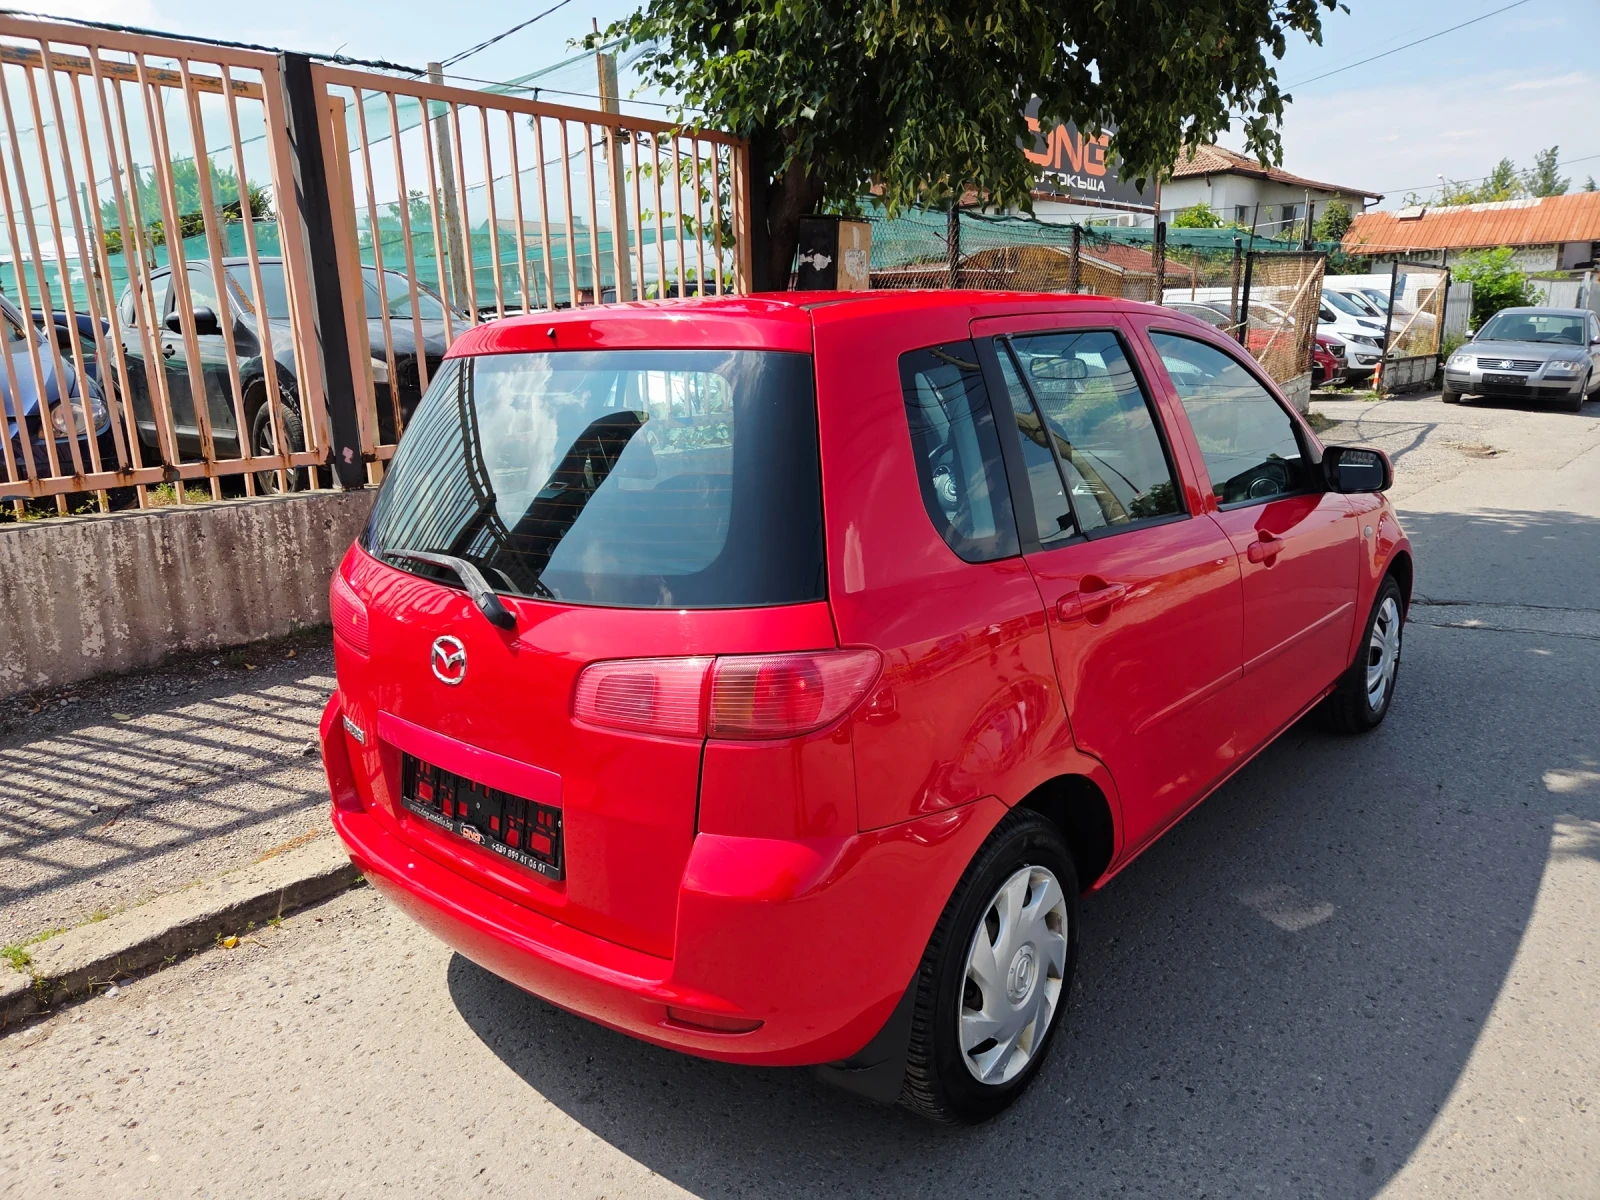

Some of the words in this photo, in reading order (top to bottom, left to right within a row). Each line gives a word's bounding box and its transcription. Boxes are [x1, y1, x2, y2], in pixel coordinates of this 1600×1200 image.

[507, 849, 519, 861] 899
[520, 855, 527, 865] 41
[529, 859, 537, 870] 06
[538, 863, 546, 874] 01
